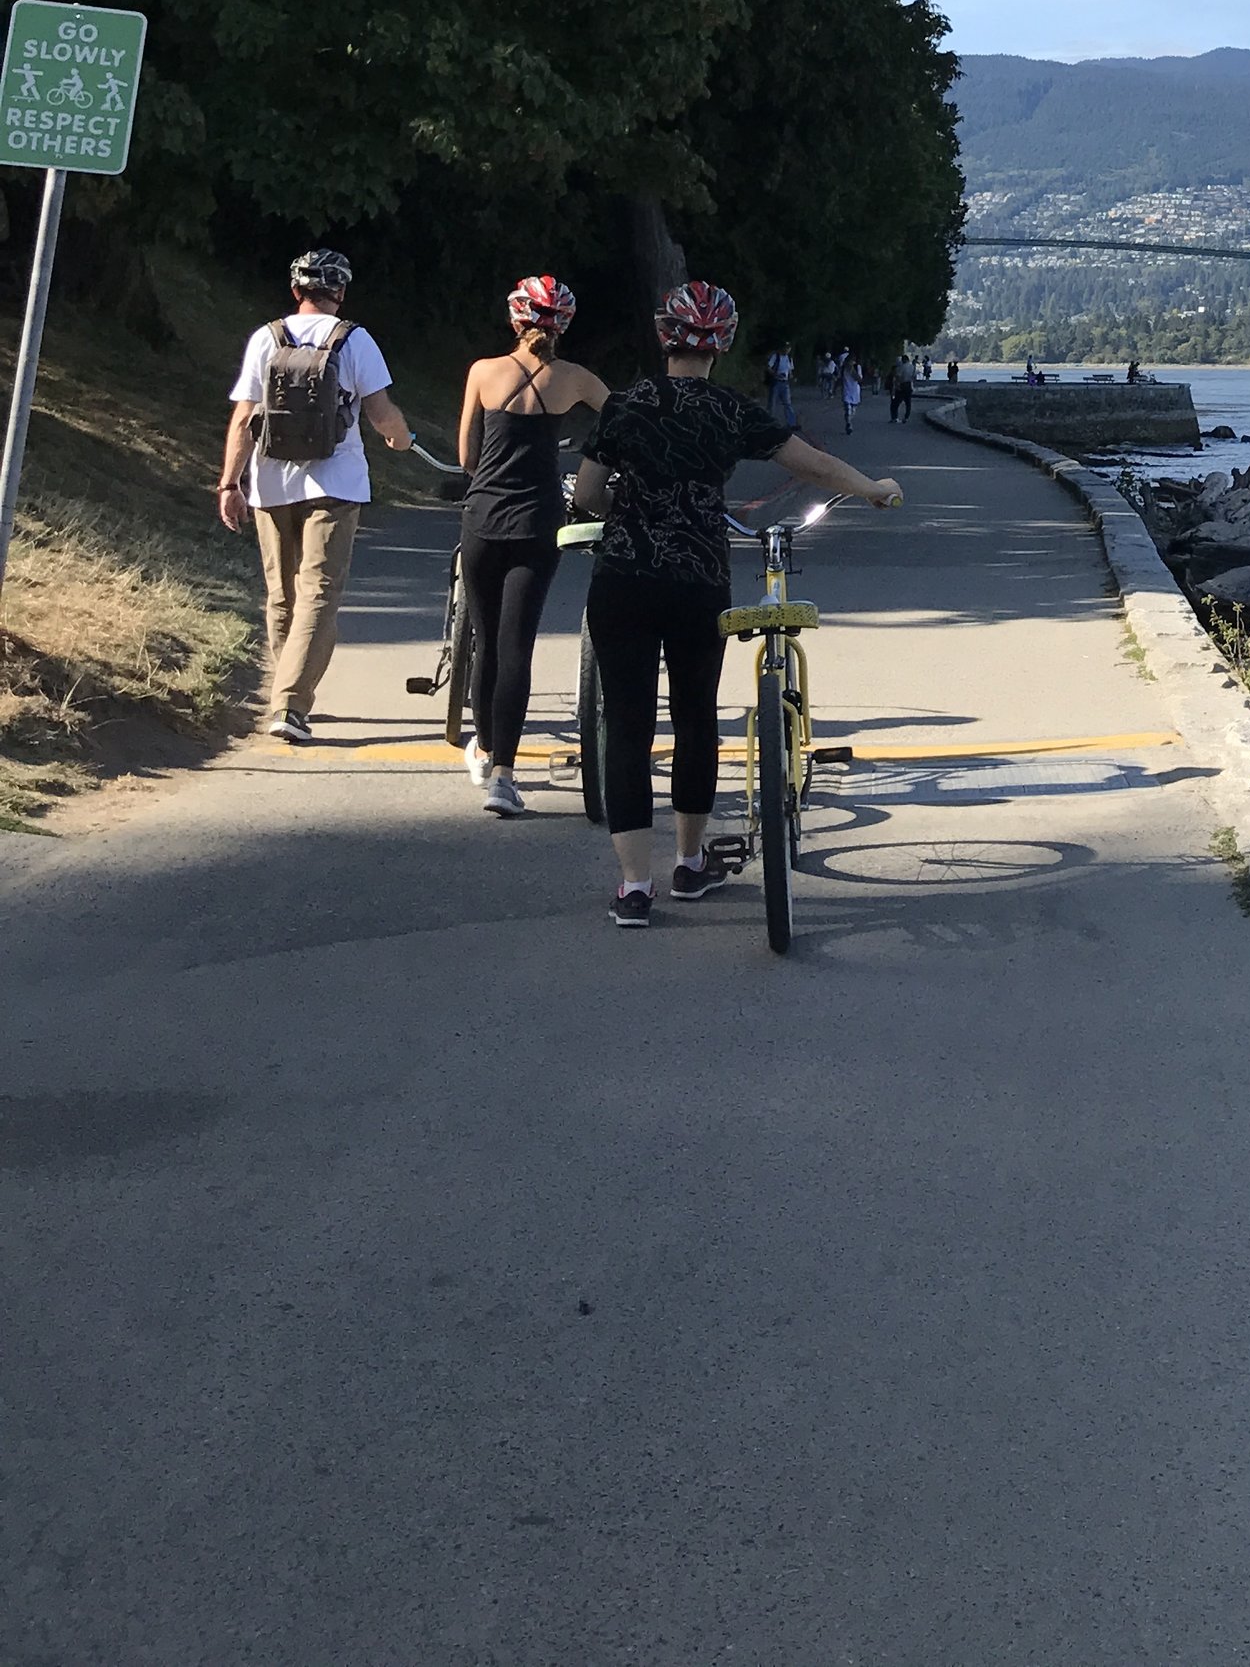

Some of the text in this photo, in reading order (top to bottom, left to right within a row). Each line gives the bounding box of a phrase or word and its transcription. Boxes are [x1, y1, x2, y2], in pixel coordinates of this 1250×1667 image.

[58, 22, 98, 42] GO
[23, 39, 125, 67] SLOWLY
[6, 108, 120, 136] RESPECT
[8, 130, 112, 157] OTHERS
